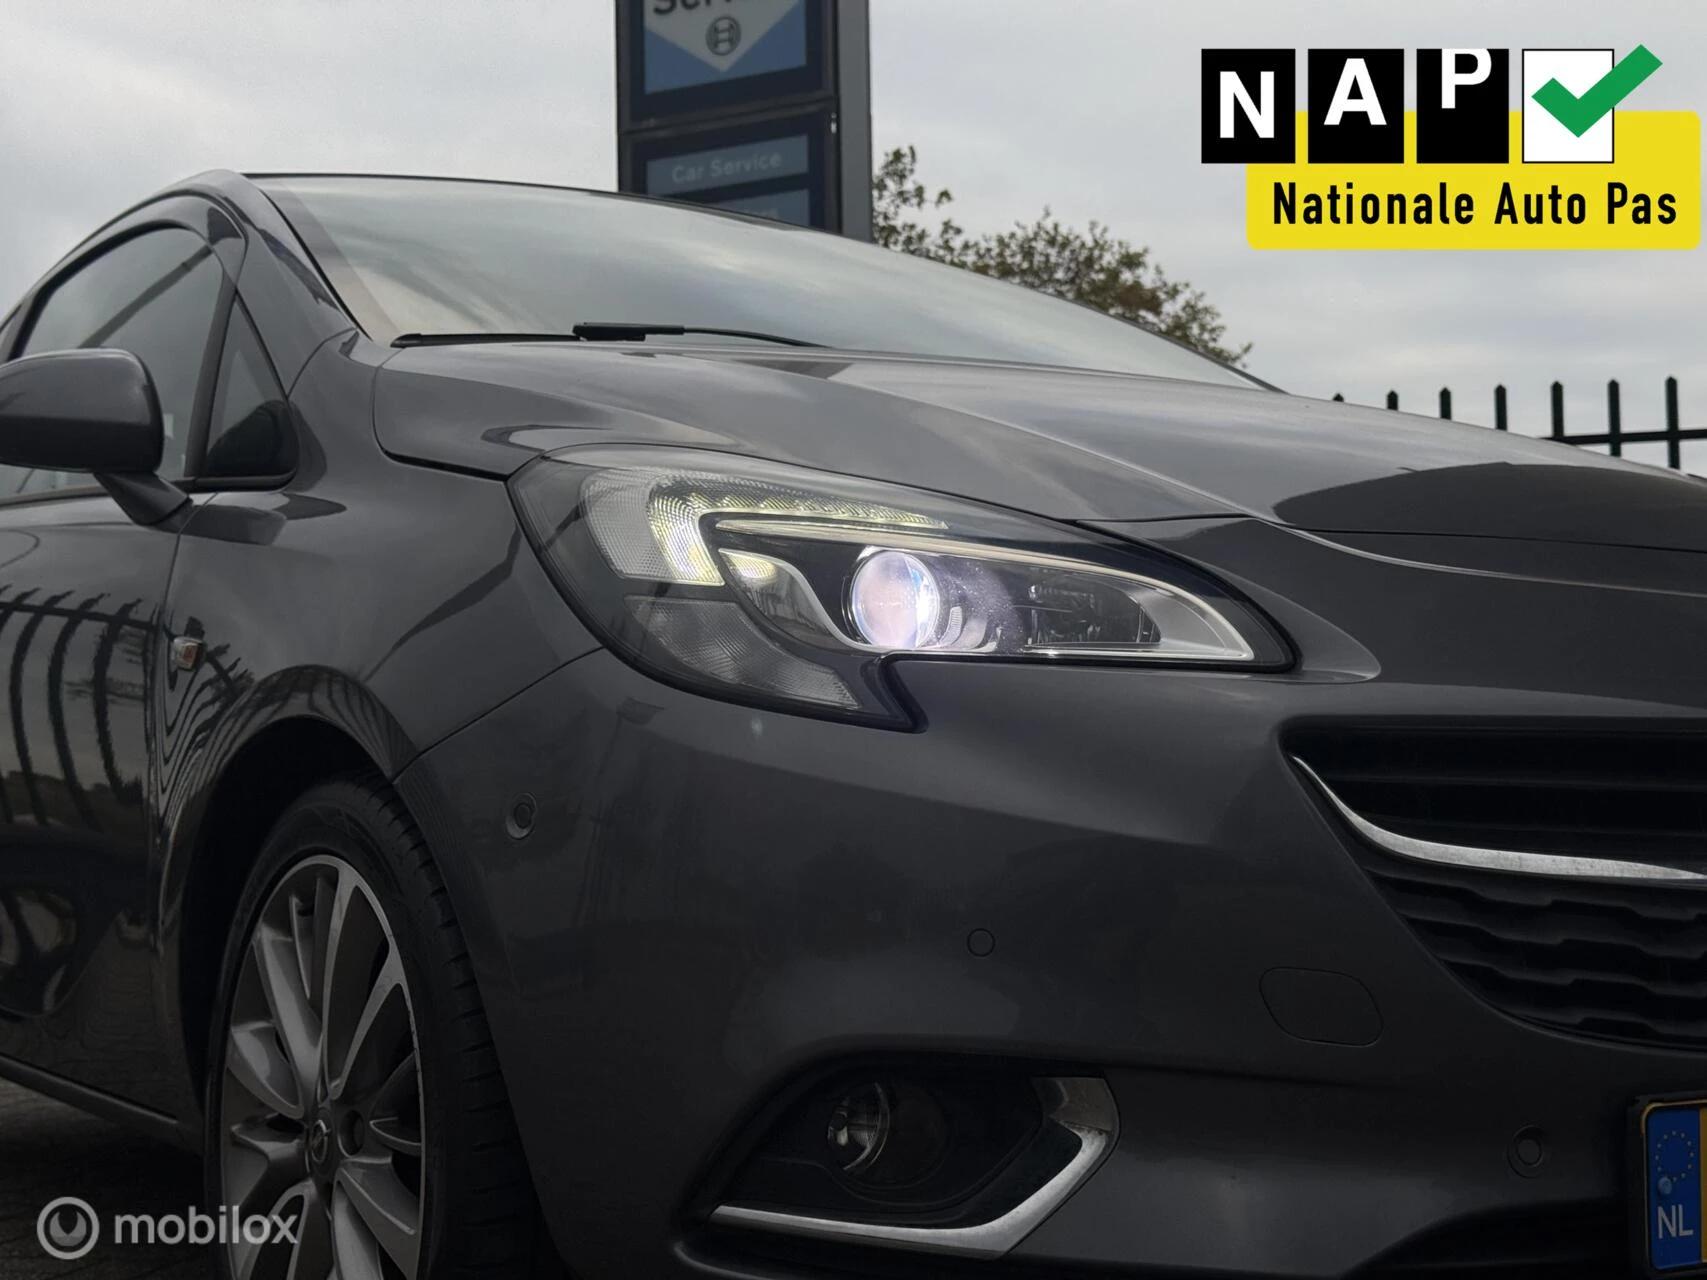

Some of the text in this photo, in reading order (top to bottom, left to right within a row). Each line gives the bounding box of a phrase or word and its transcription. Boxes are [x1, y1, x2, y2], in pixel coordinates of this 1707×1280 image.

[672, 152, 782, 184] Car Service
[1657, 1204, 1694, 1239] NL
